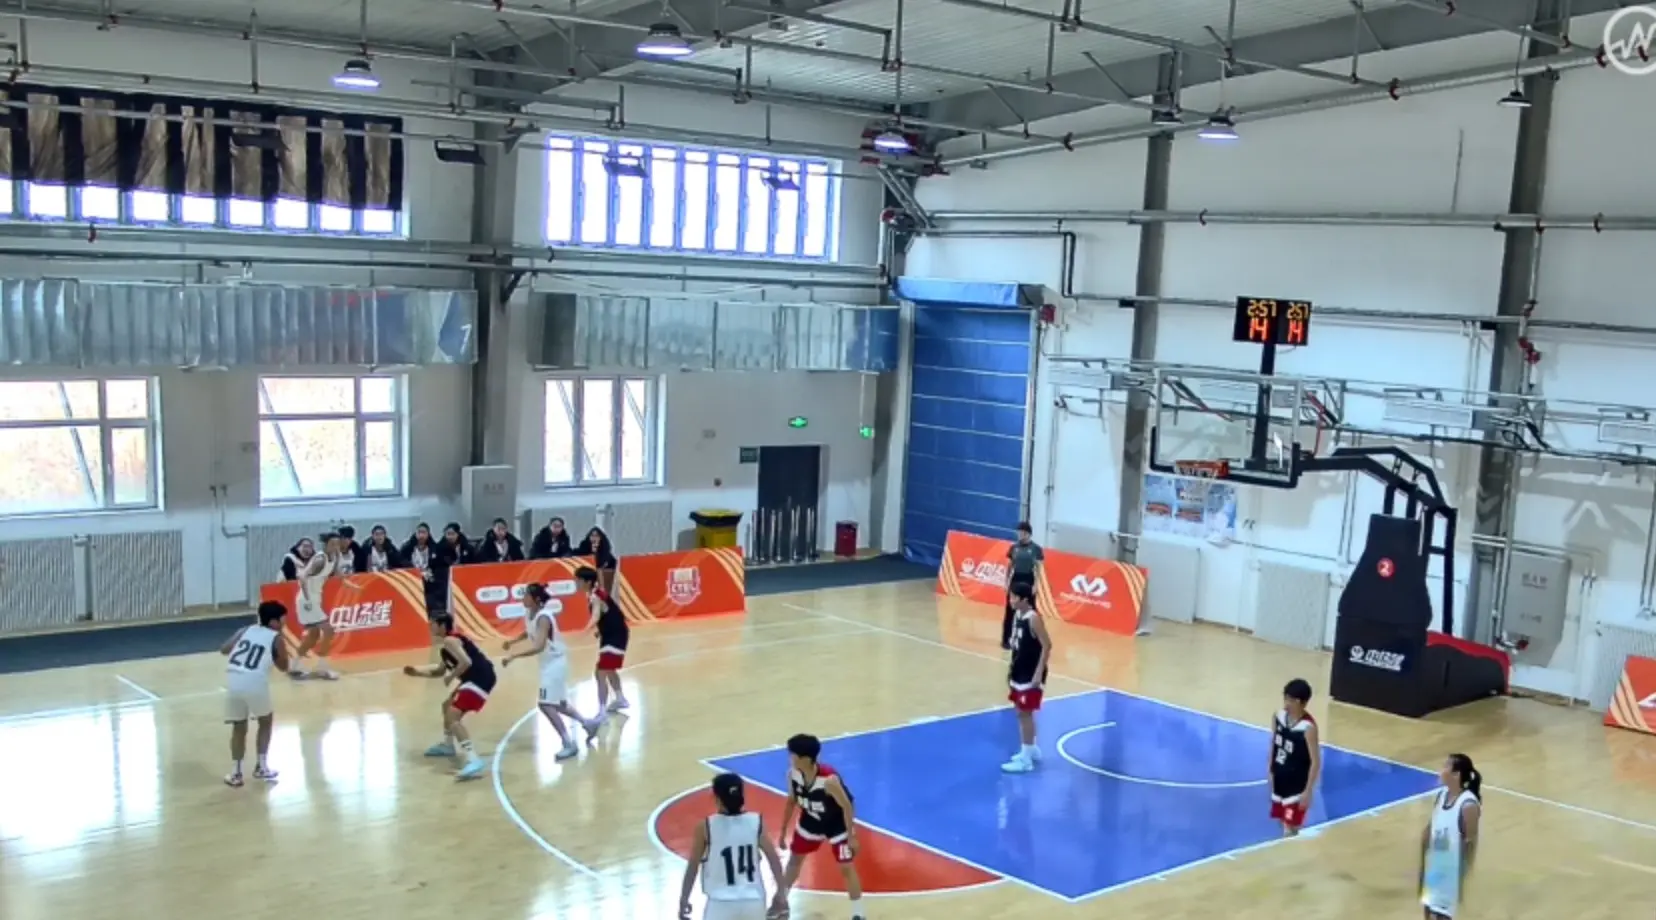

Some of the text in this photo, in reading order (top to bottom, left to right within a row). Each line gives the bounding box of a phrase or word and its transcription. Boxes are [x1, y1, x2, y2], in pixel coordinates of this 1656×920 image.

[1249, 317, 1267, 340] 14
[1287, 320, 1303, 343] 14
[229, 639, 265, 670] 20
[720, 844, 755, 886] 14
